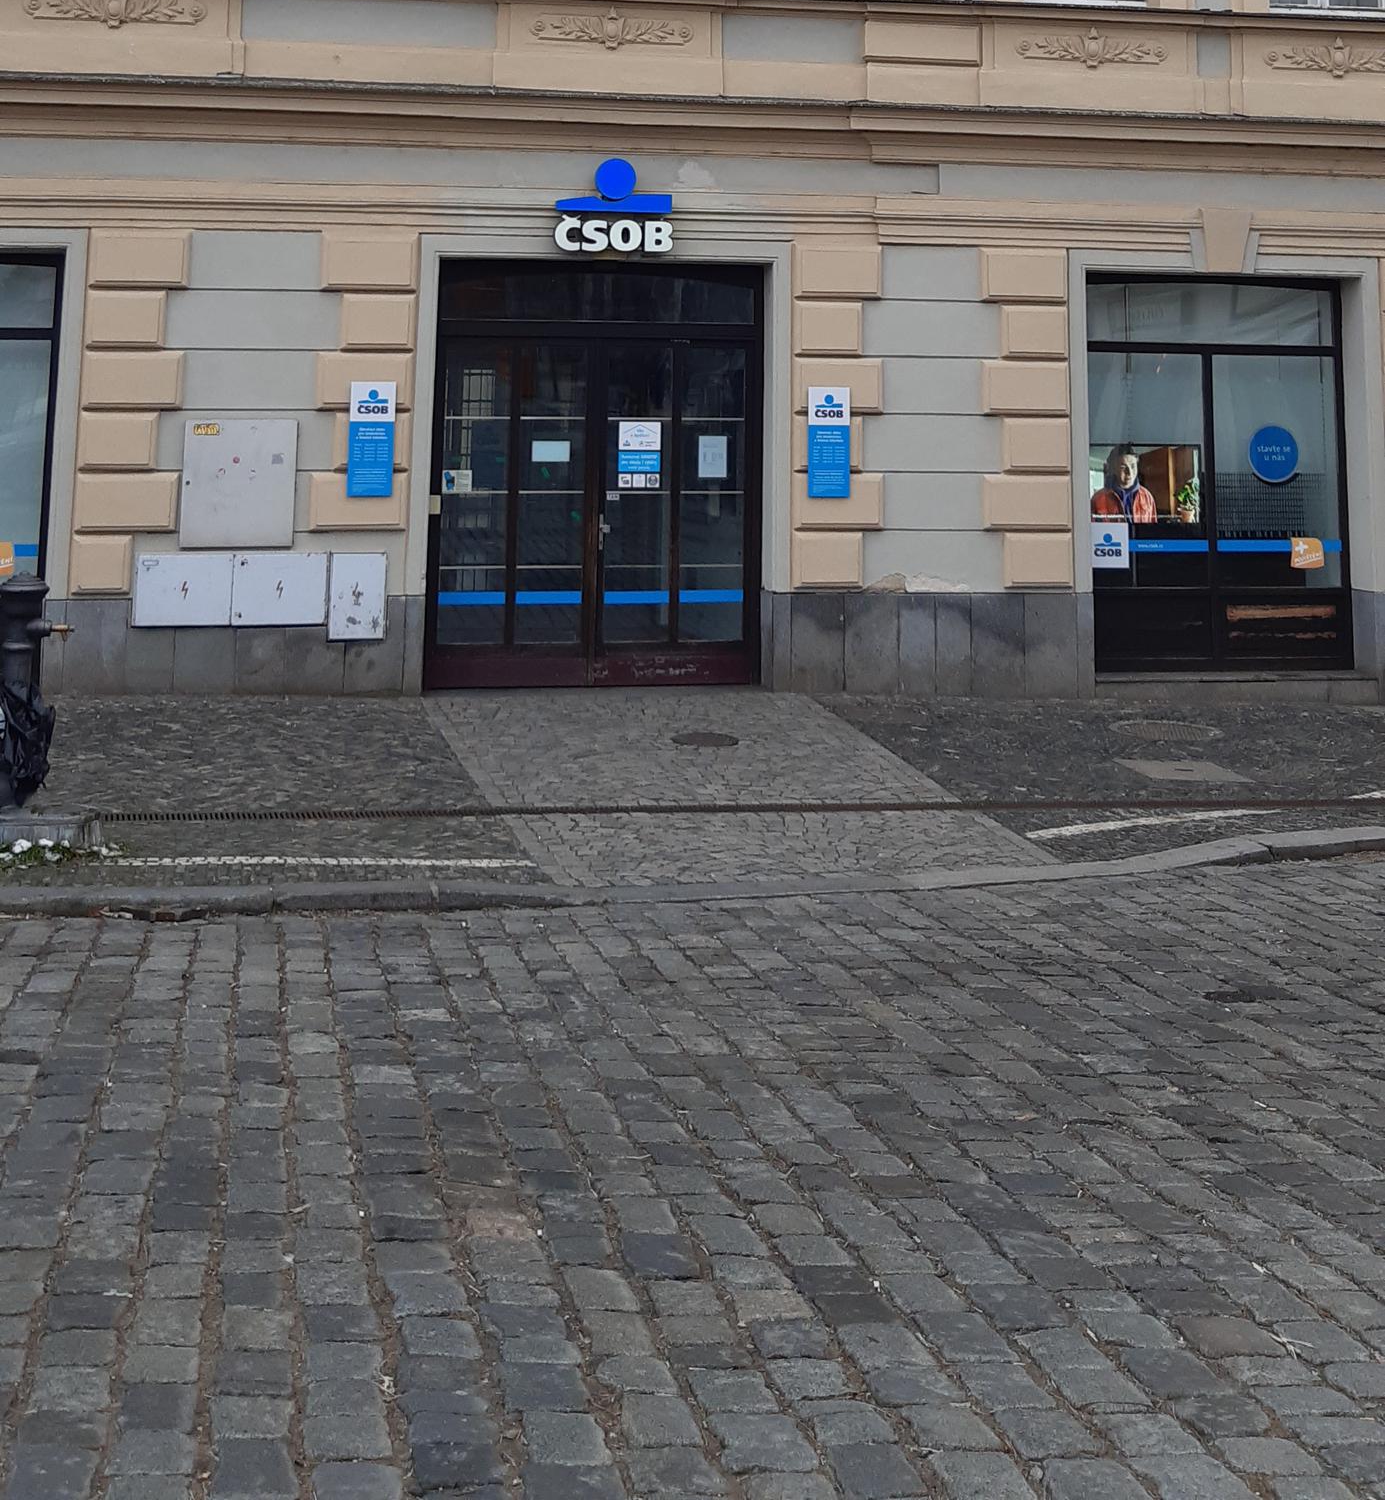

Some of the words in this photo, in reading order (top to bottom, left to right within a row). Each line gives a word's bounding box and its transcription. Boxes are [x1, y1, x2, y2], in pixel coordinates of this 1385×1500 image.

[555, 214, 673, 252] ČSOB
[357, 404, 389, 414] ČSOB
[814, 408, 844, 418] ČSOB
[1094, 547, 1122, 557] ČSOB
